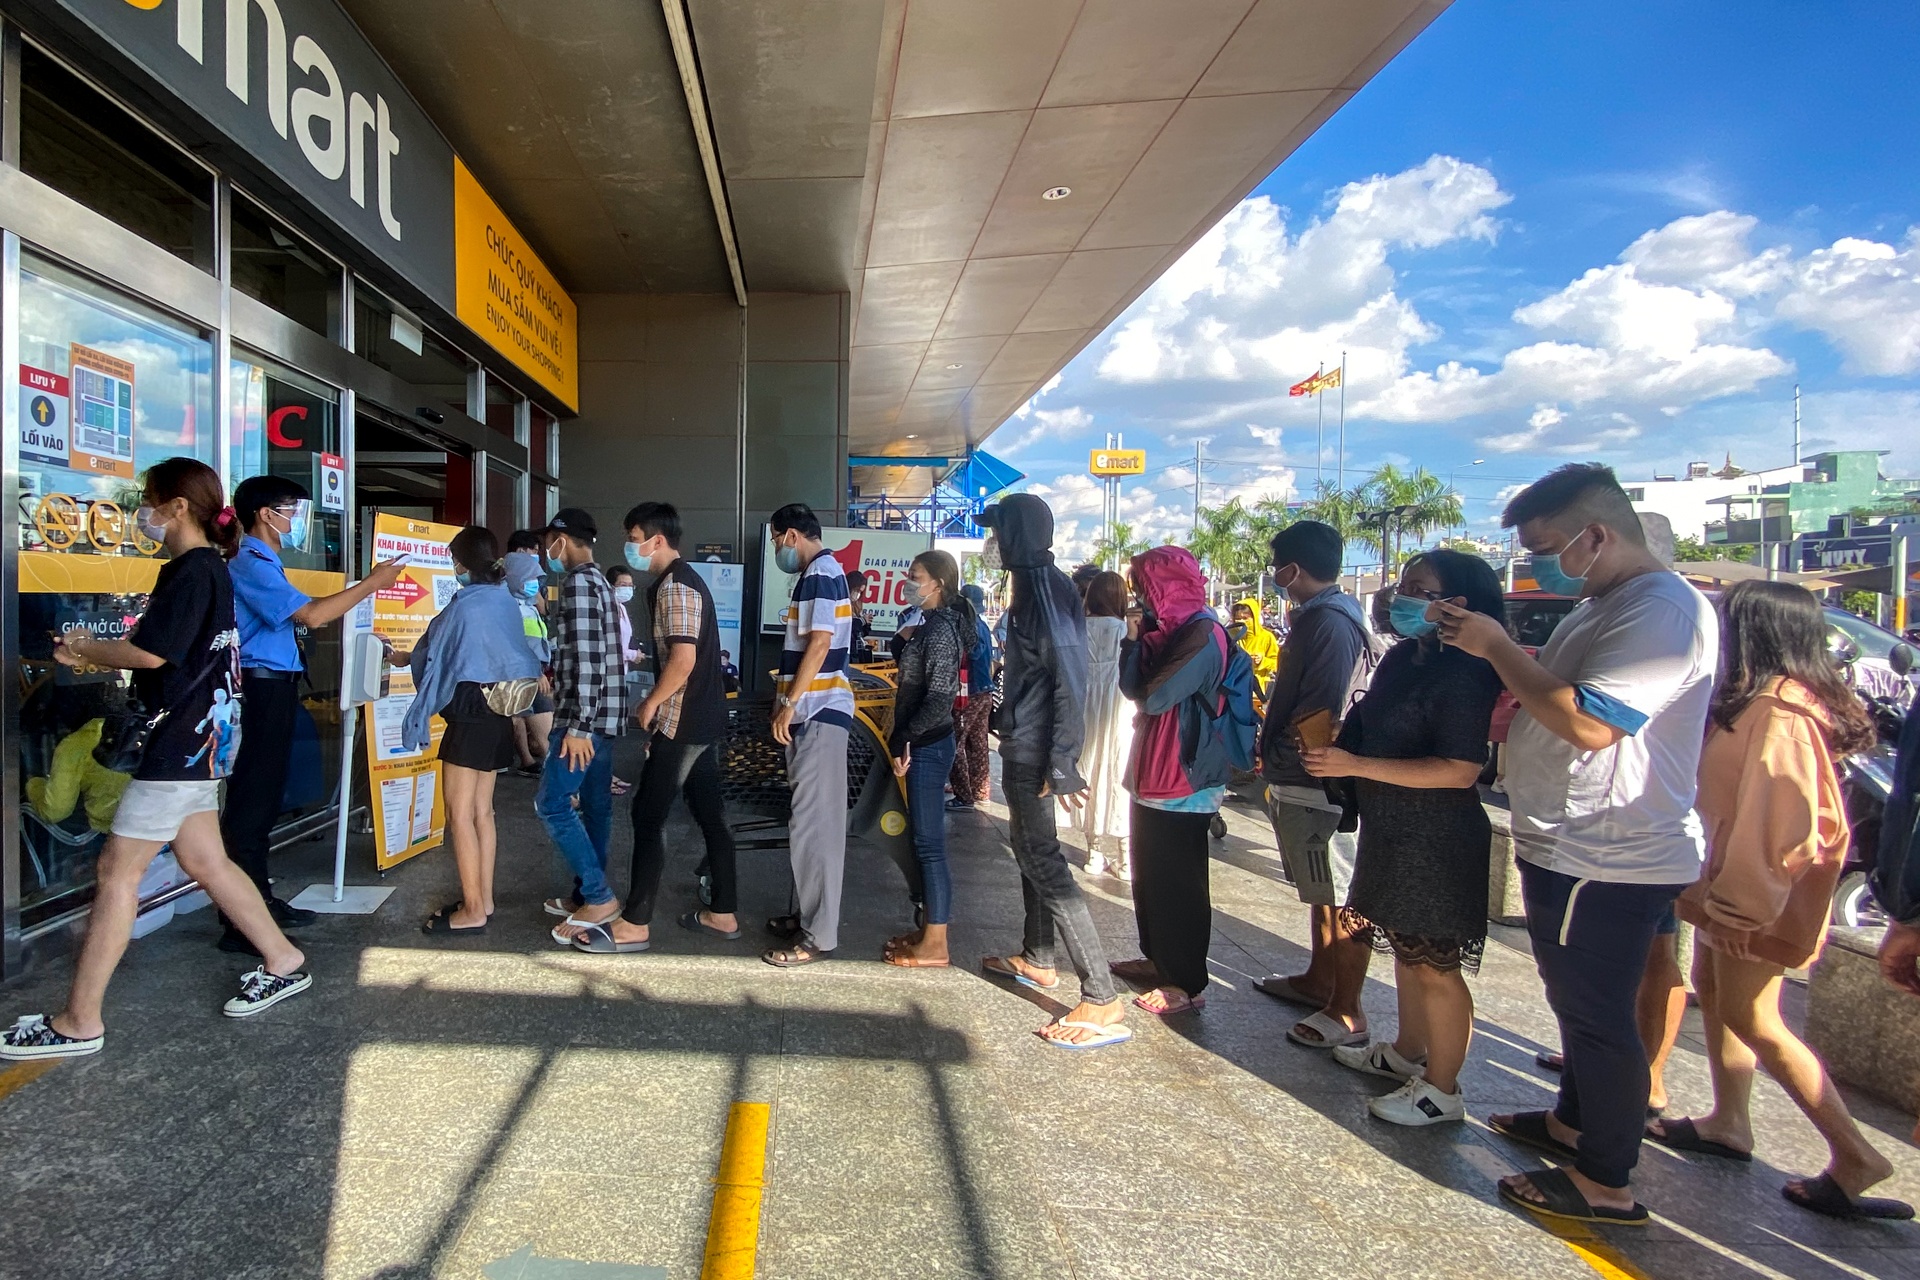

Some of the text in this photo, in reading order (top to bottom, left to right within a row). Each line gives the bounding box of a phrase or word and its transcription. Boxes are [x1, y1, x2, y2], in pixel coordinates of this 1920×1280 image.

[124, 0, 400, 241] mart
[486, 224, 563, 326] CHÚC QUÝ KHÁCH
[488, 268, 513, 312] MUA
[513, 291, 533, 331] SẮM
[534, 314, 549, 343] VUI
[486, 301, 512, 337] ENJOY
[512, 324, 531, 354] YOUR
[30, 372, 57, 390] LƯU Ý
[22, 429, 63, 451] LỐI VÀO
[90, 456, 116, 472] emart
[1096, 454, 1139, 468] emart
[408, 521, 430, 534] emart
[377, 538, 394, 550] KHAI
[397, 540, 412, 553] BÁO
[414, 544, 419, 553] Y
[420, 542, 430, 554] TẾ
[865, 557, 910, 568] GIAO HÀN
[862, 609, 885, 617] RONG
[62, 619, 85, 634] GIỜ
[87, 619, 107, 633] MỞ
